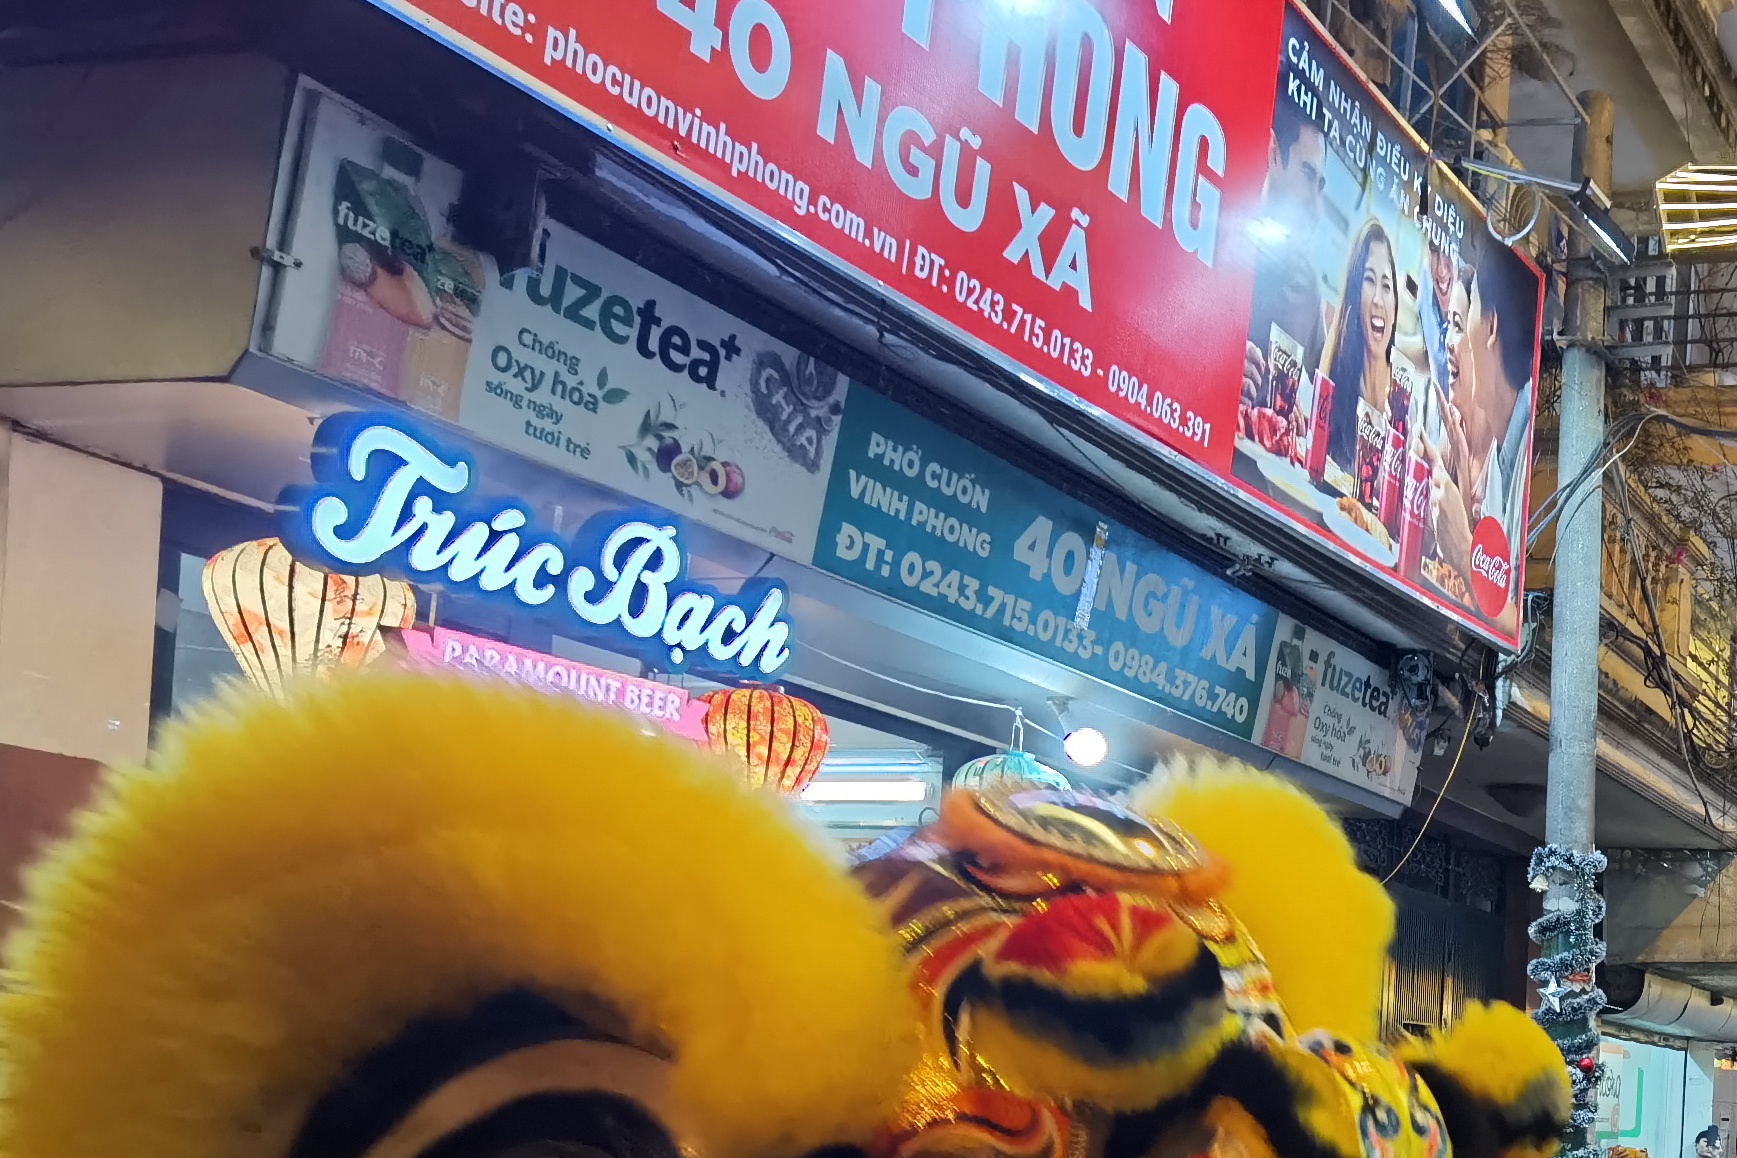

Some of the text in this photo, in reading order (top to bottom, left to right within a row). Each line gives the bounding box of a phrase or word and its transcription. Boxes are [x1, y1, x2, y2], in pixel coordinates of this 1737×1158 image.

[1288, 37, 1325, 91] CẢM
[1287, 72, 1317, 121] KHI
[1322, 107, 1340, 145] TA
[655, 0, 1093, 312] 40 NGŨ XÃ
[544, 25, 898, 263] phocuonvinhphong.com.vn
[914, 245, 952, 293] ĐT:
[954, 270, 1093, 378] 0243.715.0133
[1108, 364, 1211, 448] 0904.063.391
[490, 344, 545, 393] Oxy
[551, 373, 599, 414] hóa
[517, 327, 581, 375] Chống
[484, 379, 525, 410] sống
[526, 395, 564, 425] ngày
[565, 438, 592, 460] trẻ
[868, 431, 990, 513] PHỞ CUỐN
[311, 425, 791, 674] Trúc Bạch
[849, 469, 991, 558] VINH PHONG
[1014, 516, 1087, 595] 40
[1471, 543, 1509, 590] Coca-Cola
[836, 521, 893, 577] ĐT:
[1108, 641, 1249, 723] 0984.376.740
[443, 639, 681, 722] PARAMOUNT BEER
